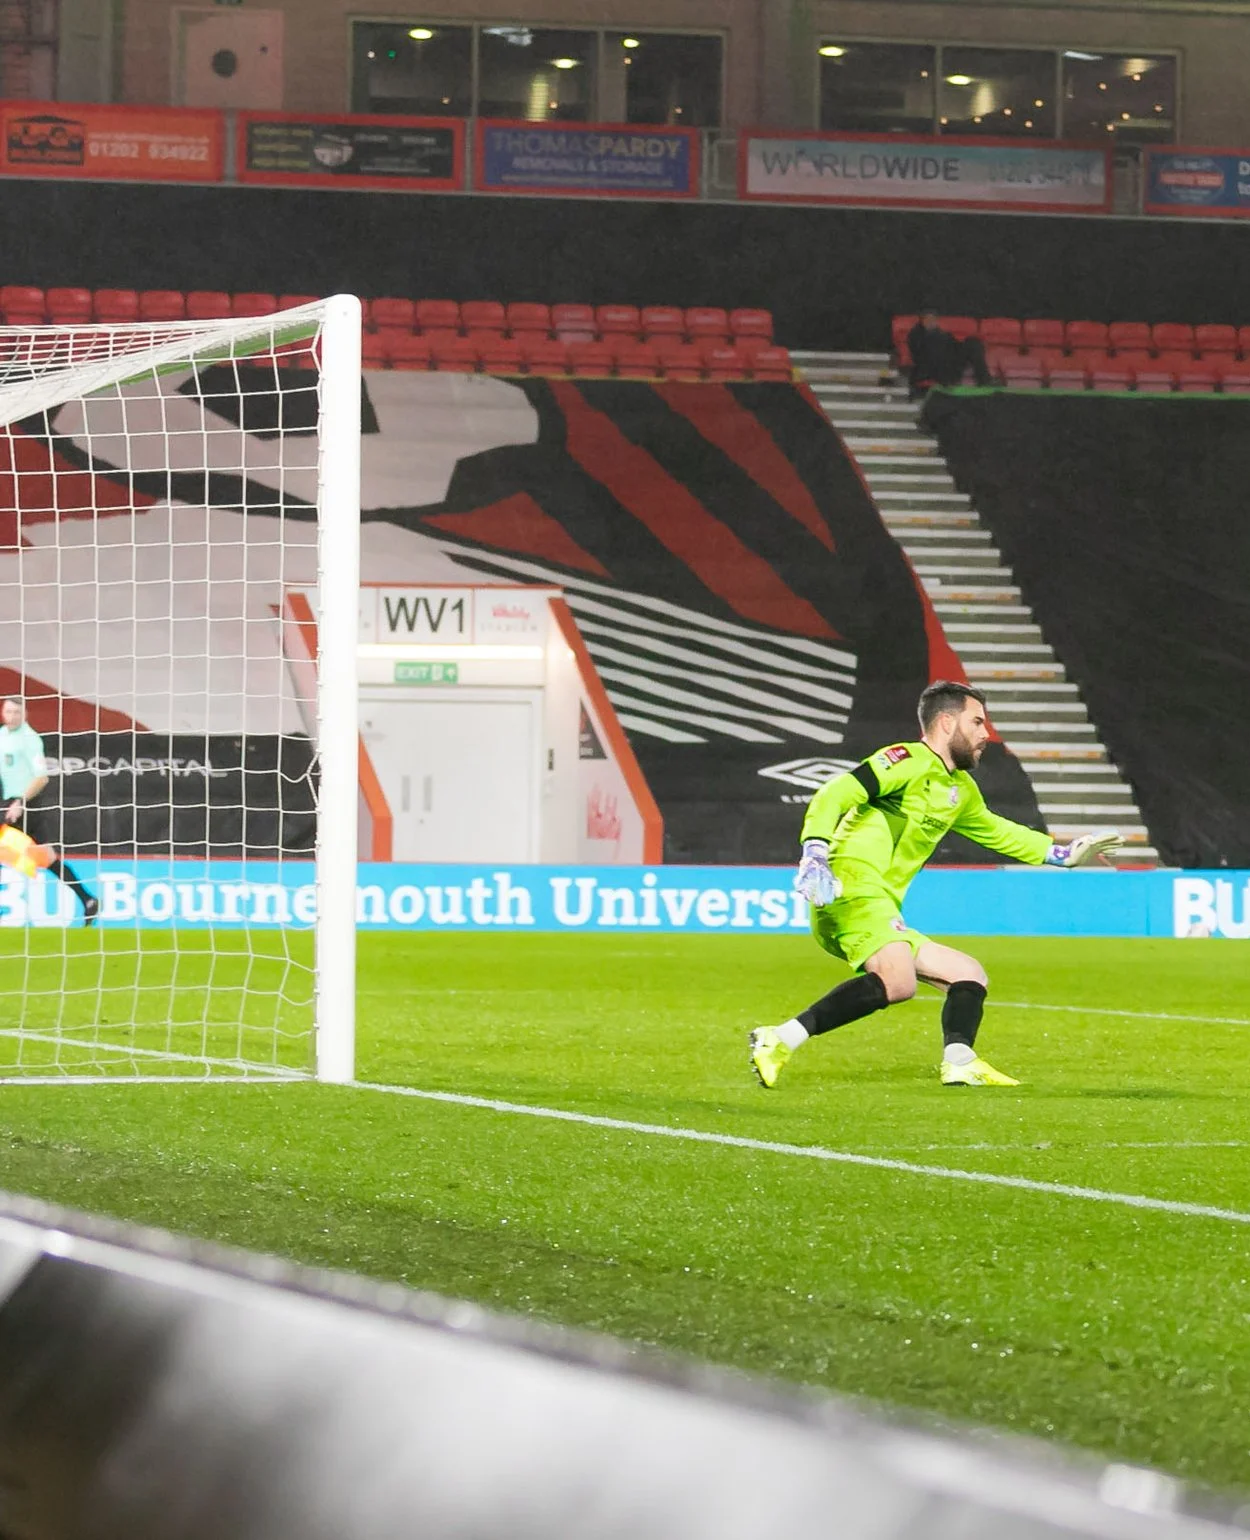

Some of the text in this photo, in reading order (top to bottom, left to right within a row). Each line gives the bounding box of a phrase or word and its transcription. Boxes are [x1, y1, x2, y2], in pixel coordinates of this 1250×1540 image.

[384, 596, 465, 633] WV1
[398, 665, 430, 681] EXIT
[549, 873, 811, 927] Universi
